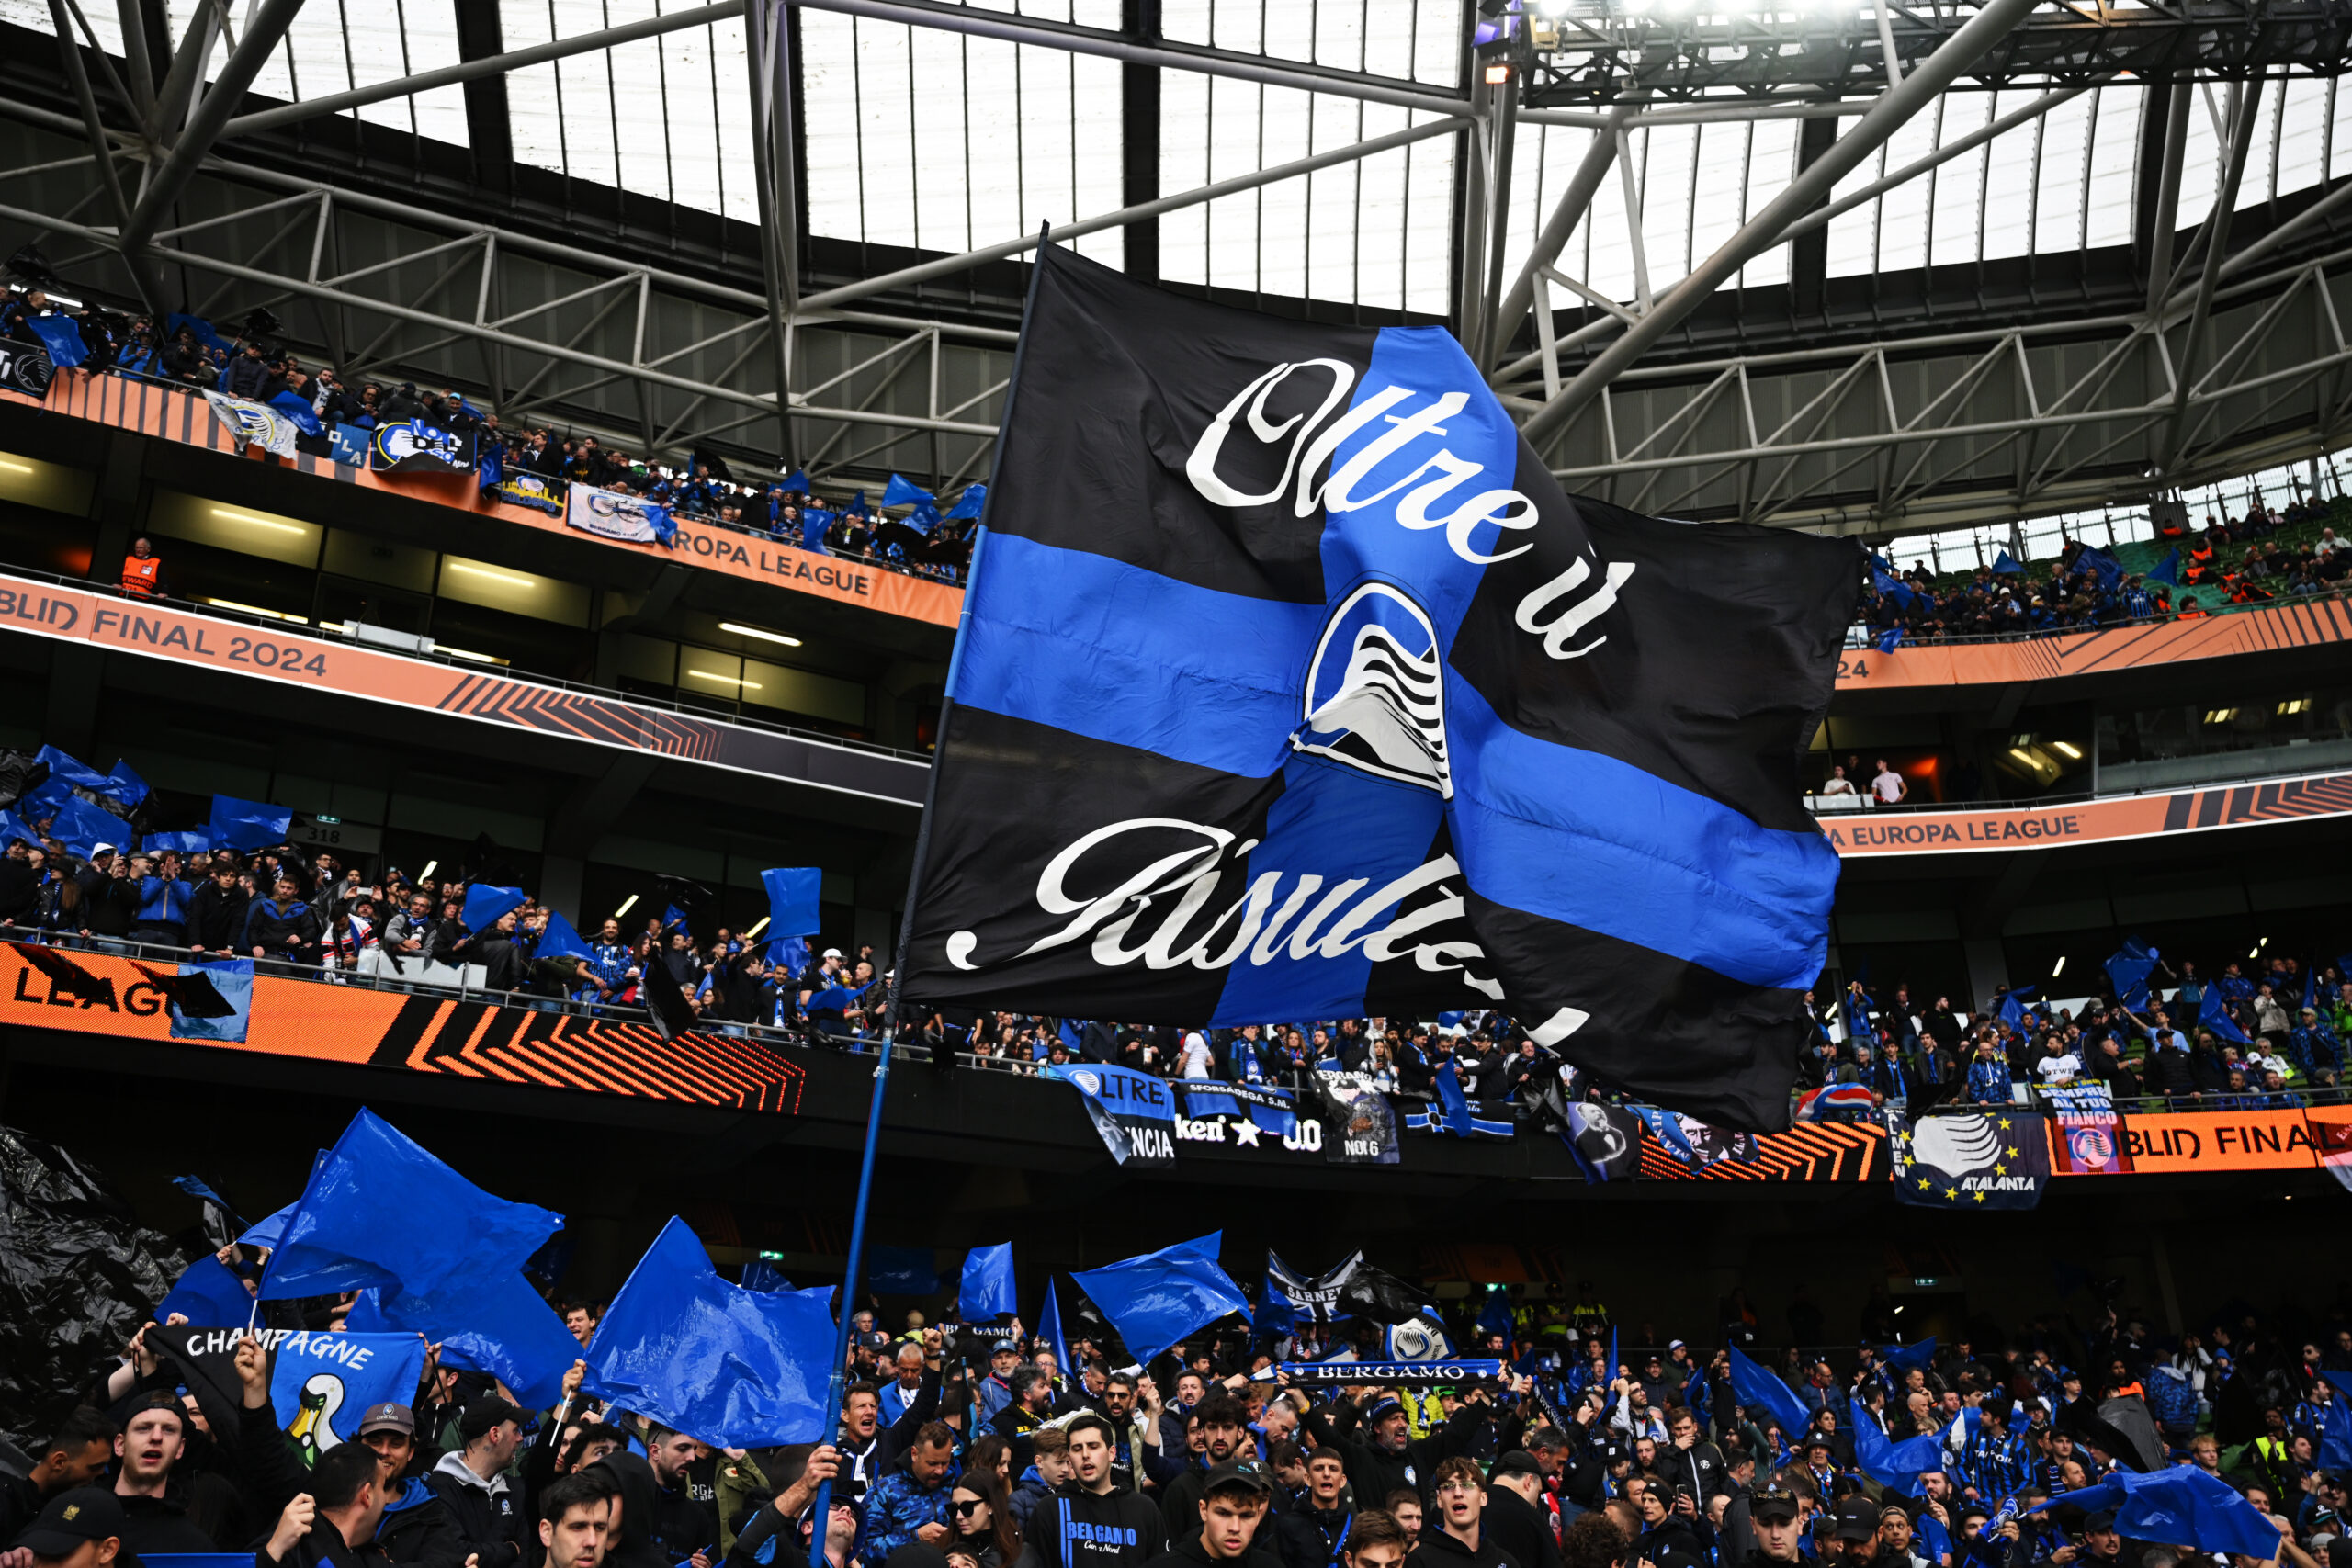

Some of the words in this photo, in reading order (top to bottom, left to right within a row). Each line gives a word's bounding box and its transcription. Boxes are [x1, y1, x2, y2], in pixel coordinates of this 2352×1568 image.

[1186, 358, 1539, 564] Oltre
[672, 529, 732, 568] ROPA
[760, 551, 869, 596] LEAGUE
[93, 609, 216, 656] FINAL
[228, 637, 327, 677] 2024
[308, 827, 341, 844] 318
[1852, 822, 1962, 846] EUROPA
[1967, 815, 2080, 842] LEAGUE
[2038, 1085, 2110, 1099] SEMPRE
[2051, 1098, 2075, 1109] AL
[2074, 1097, 2113, 1109] TUO
[2056, 1110, 2118, 1126] FIANCO
[1125, 1126, 1175, 1158] NCIA
[1960, 1176, 2036, 1192] ATALANTA
[945, 1324, 1014, 1337] BGAMO
[187, 1326, 374, 1371] CHAMPAGNE
[1317, 1364, 1465, 1380] BERGAMO
